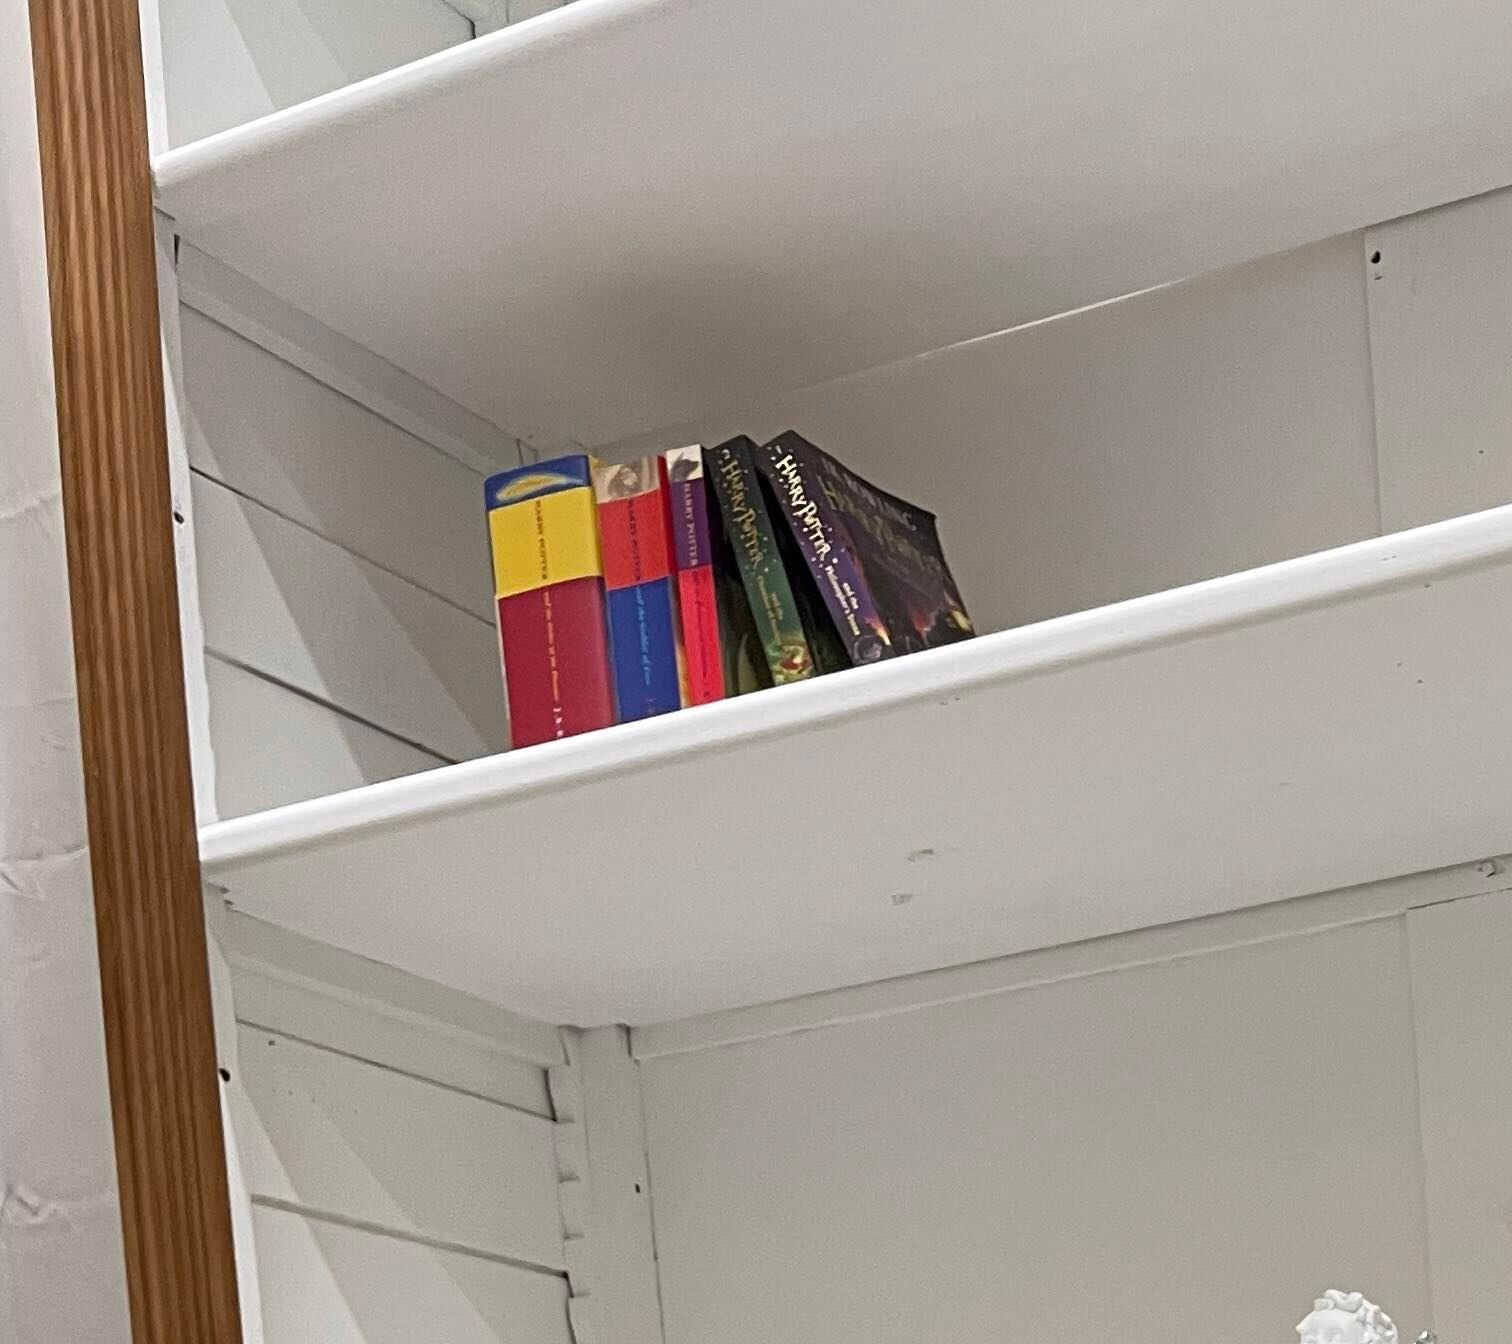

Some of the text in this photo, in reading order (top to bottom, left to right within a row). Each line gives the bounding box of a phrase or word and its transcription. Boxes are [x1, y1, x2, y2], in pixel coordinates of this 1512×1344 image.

[720, 459, 748, 513] HARRY
[775, 454, 831, 561] HARRY POTTER
[683, 482, 699, 567] HARRY POTTER
[732, 508, 764, 570] POTTER
